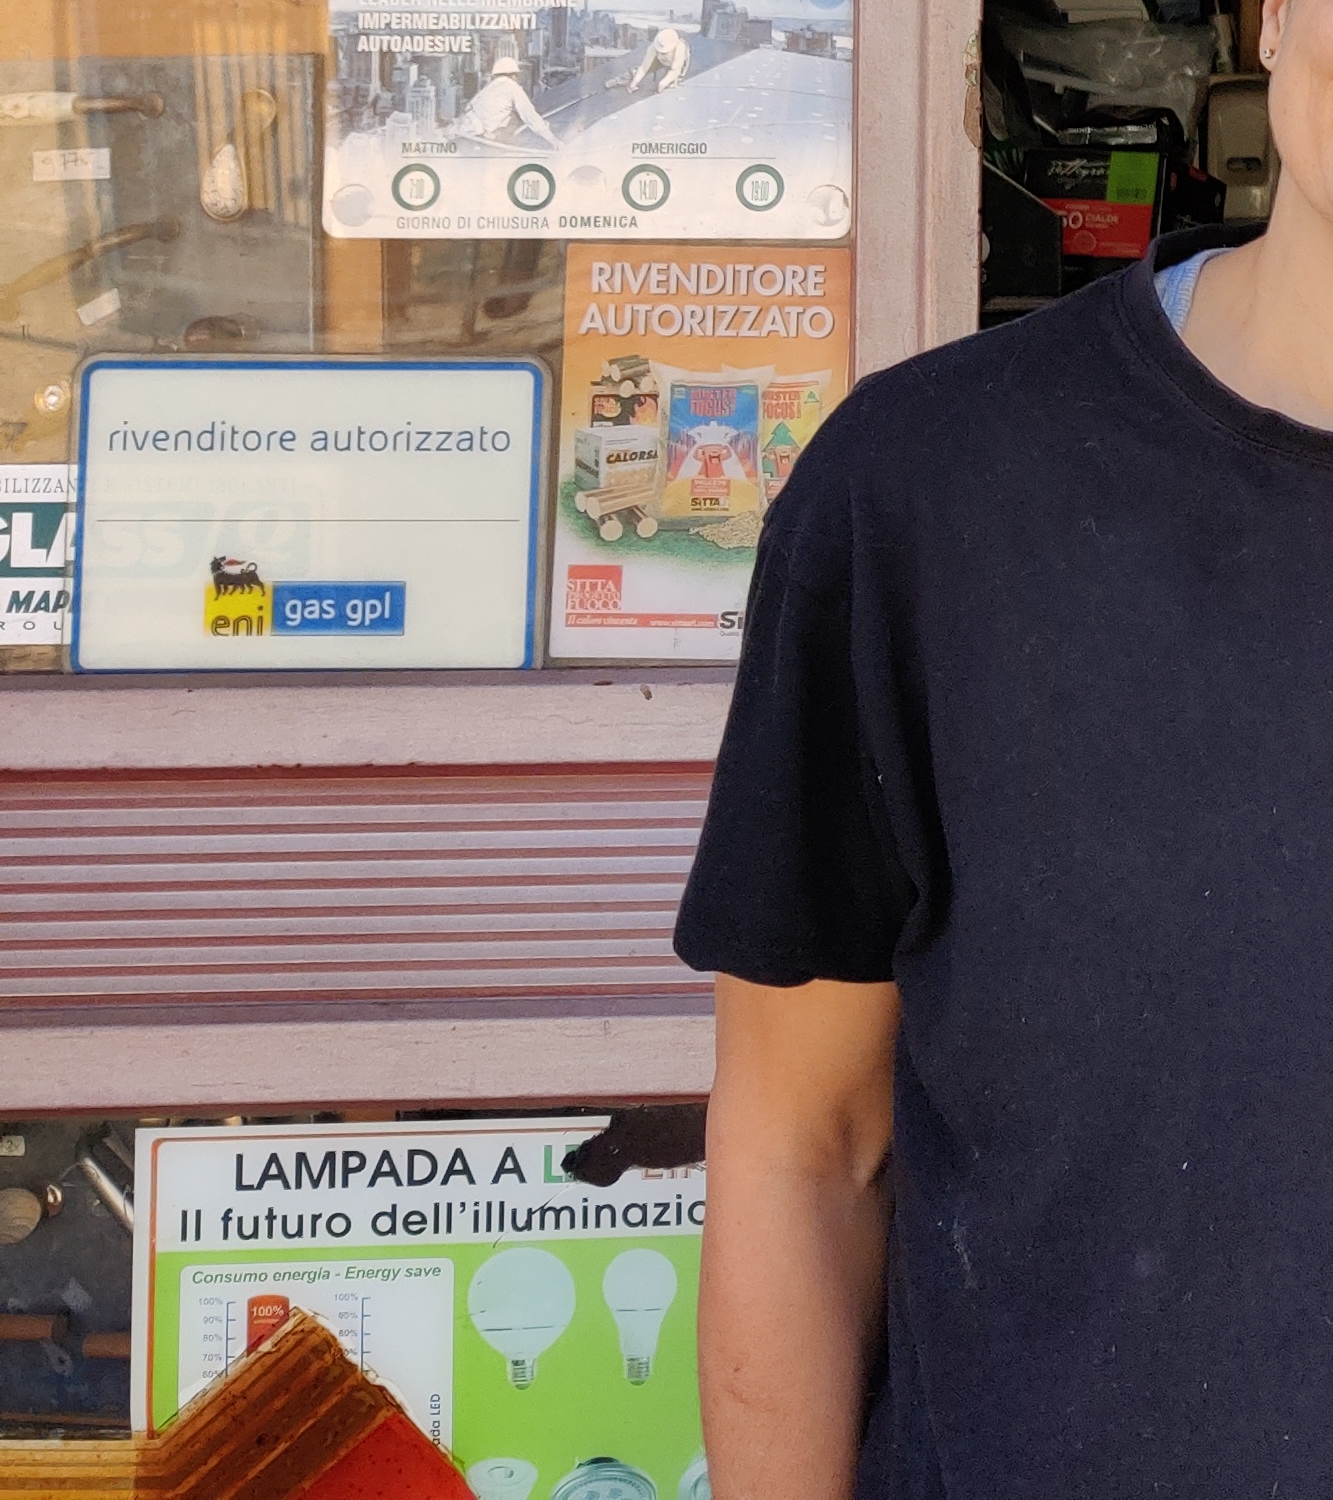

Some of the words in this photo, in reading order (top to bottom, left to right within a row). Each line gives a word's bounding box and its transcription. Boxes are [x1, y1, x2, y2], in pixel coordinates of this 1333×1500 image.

[358, 12, 538, 31] IMPERMEABILIZZANTI
[357, 34, 473, 53] AUTOADESIVE
[401, 142, 457, 154] MATTINO
[631, 142, 708, 155] POMERIGGIO
[396, 216, 451, 229] GIORNO
[457, 216, 471, 229] DI
[477, 216, 550, 229] CHIUSURA
[558, 215, 638, 228] DOMENICA
[591, 261, 826, 297] RIVENDITORE
[578, 302, 834, 339] AUTORIZZATO
[108, 420, 297, 452] rivenditore
[310, 422, 511, 453] autorizzato
[566, 579, 615, 592] SITTA
[284, 597, 336, 627] gas
[346, 591, 391, 626] gpl
[567, 599, 621, 610] FUOCO
[210, 606, 264, 636] eni
[234, 1147, 475, 1191] LAMPADA
[490, 1146, 528, 1185] A
[180, 1208, 201, 1242] Il
[221, 1207, 352, 1241] futuro
[191, 1270, 268, 1284] Consumo
[273, 1267, 331, 1284] energia
[344, 1265, 402, 1281] Energy
[405, 1266, 442, 1278] save
[250, 1305, 285, 1316] 100%
[430, 1393, 441, 1417] LED
